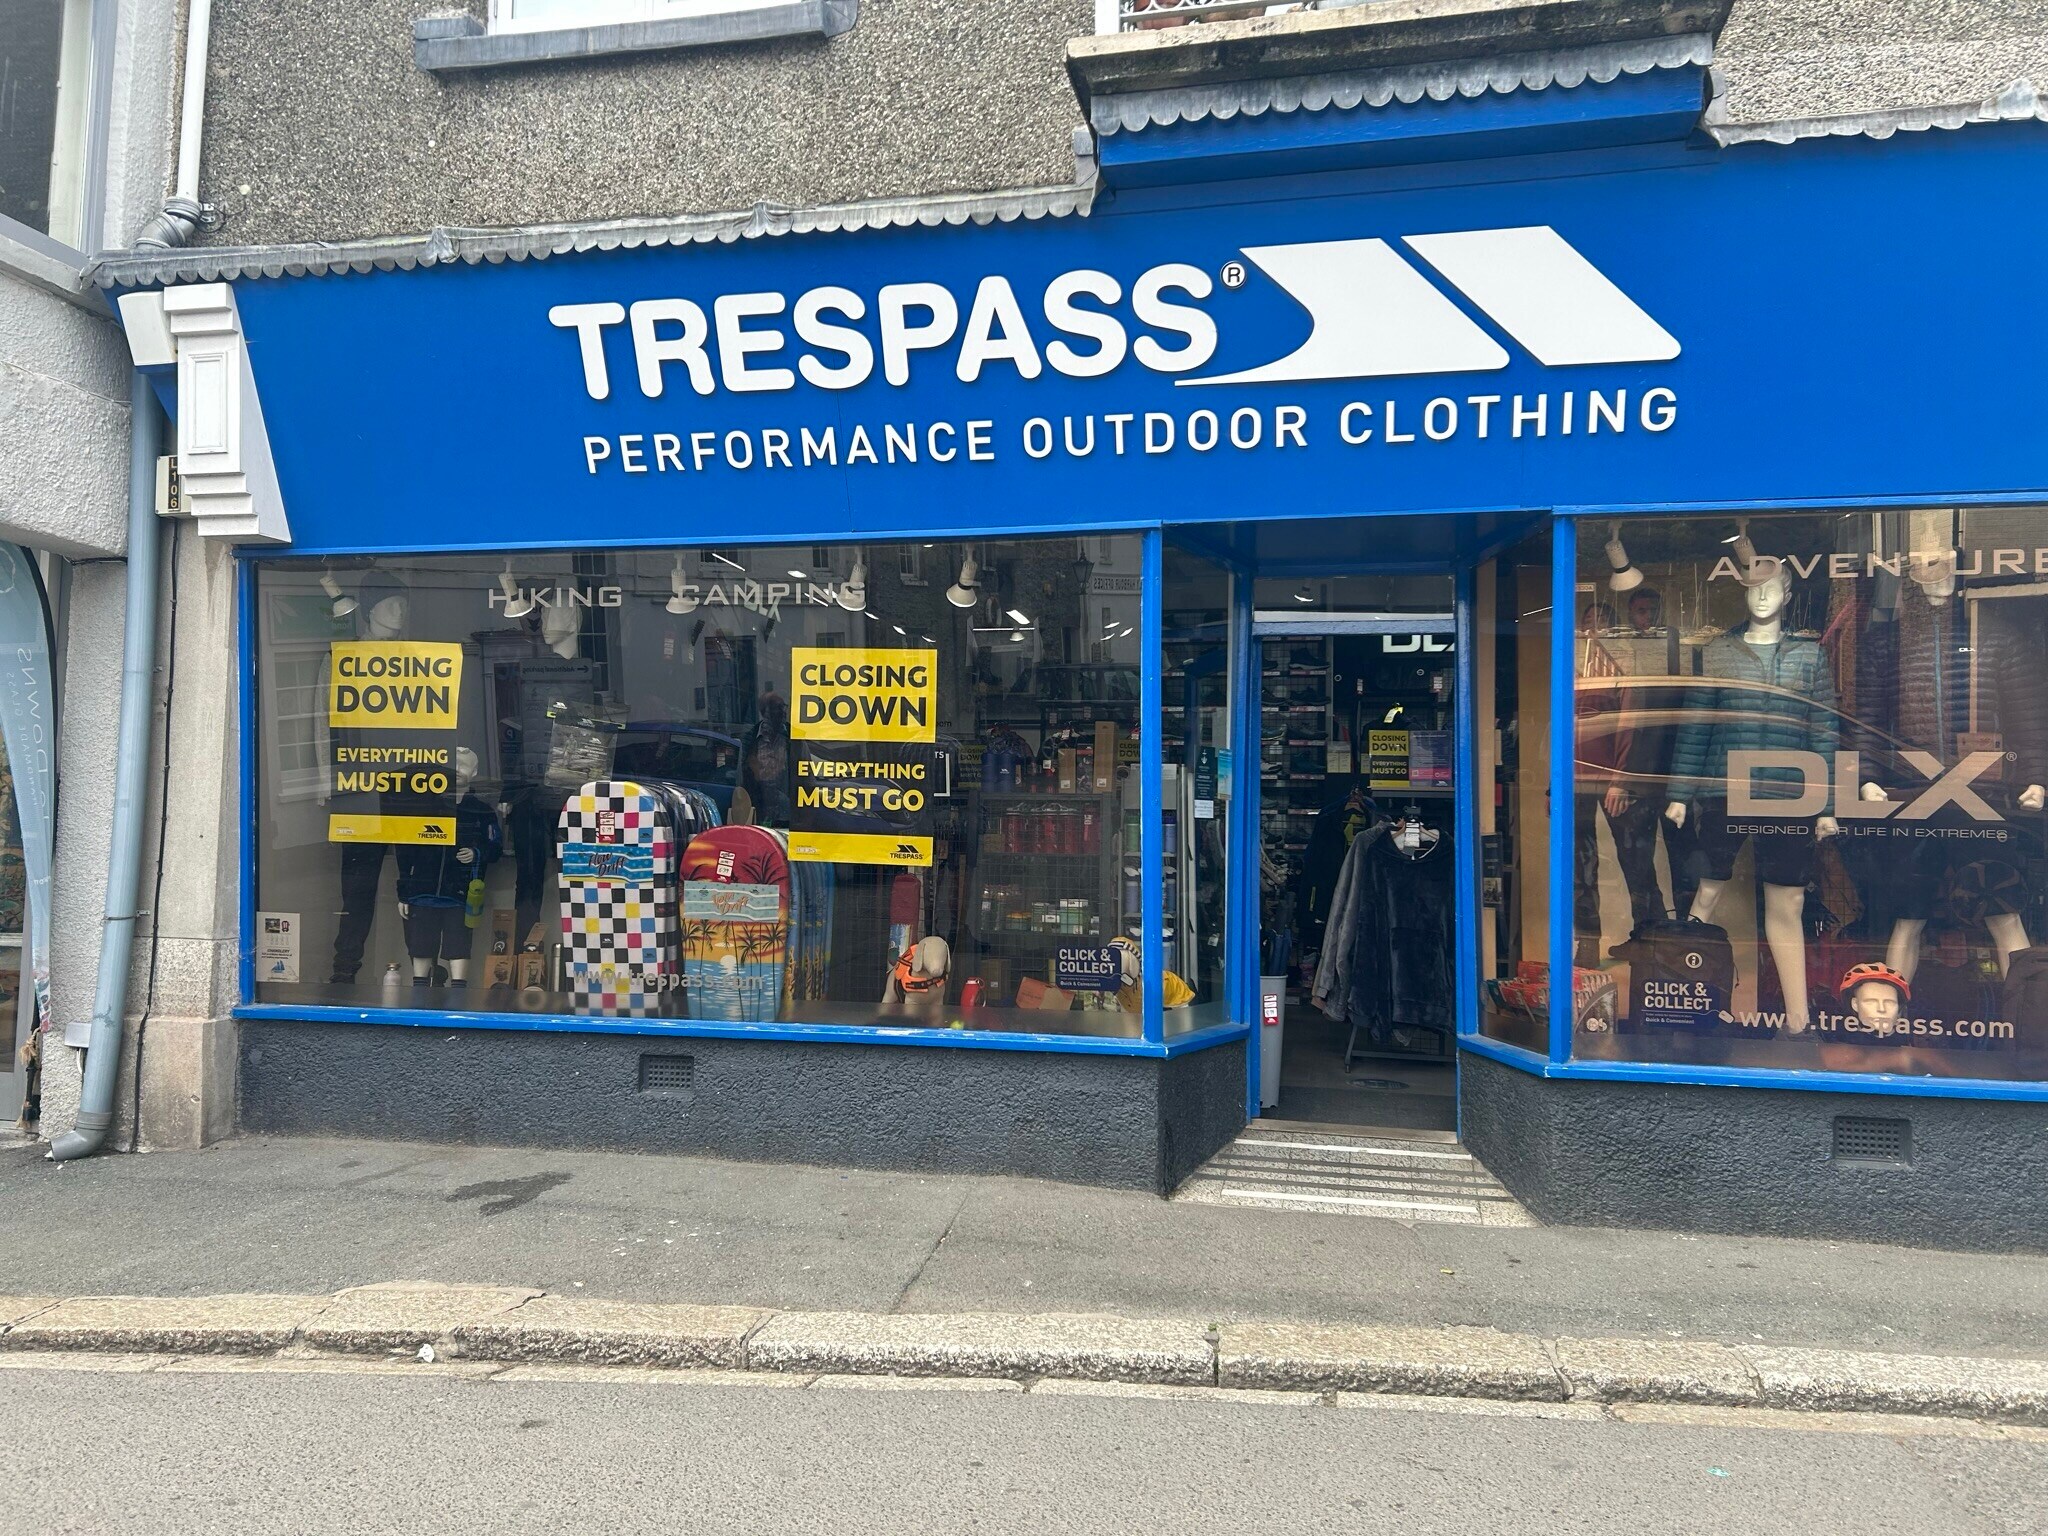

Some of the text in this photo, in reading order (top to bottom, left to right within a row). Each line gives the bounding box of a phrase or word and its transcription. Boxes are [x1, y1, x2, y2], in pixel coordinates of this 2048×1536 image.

[548, 263, 1218, 400] TRESPASS
[583, 386, 1679, 474] PERFORMANCE OUTDOOR CLOTHING
[488, 586, 622, 609] HIKING
[677, 581, 866, 607] CAMPING
[1382, 634, 1455, 652] DL
[338, 656, 453, 678] CLOSING
[799, 664, 928, 688] CLOSING
[336, 685, 450, 714] DOWN
[799, 694, 927, 727] DOWN
[1372, 734, 1406, 742] CLOSING
[1372, 743, 1407, 752] DOWN
[337, 747, 449, 764] EVERYTHING
[797, 761, 926, 780] EVERYTHING
[337, 772, 449, 794] MUST GO
[1727, 750, 2007, 821] DLX
[797, 786, 925, 812] MUST GO
[417, 832, 448, 840] TRESPASS
[1726, 824, 1809, 835] DESIGNED
[1854, 827, 1887, 836] LIFE
[1892, 827, 1909, 837] IN
[1915, 828, 2008, 839] EXTREMES
[889, 852, 923, 860] TRESPASS
[1059, 948, 1112, 961] CLICK &
[1059, 961, 1116, 974] COLLECT
[573, 968, 765, 992] www.trespass.com
[1644, 982, 1707, 996] CLICK &
[1644, 995, 1713, 1010] COLLECT
[1739, 1010, 2015, 1039] www.trespass.com
